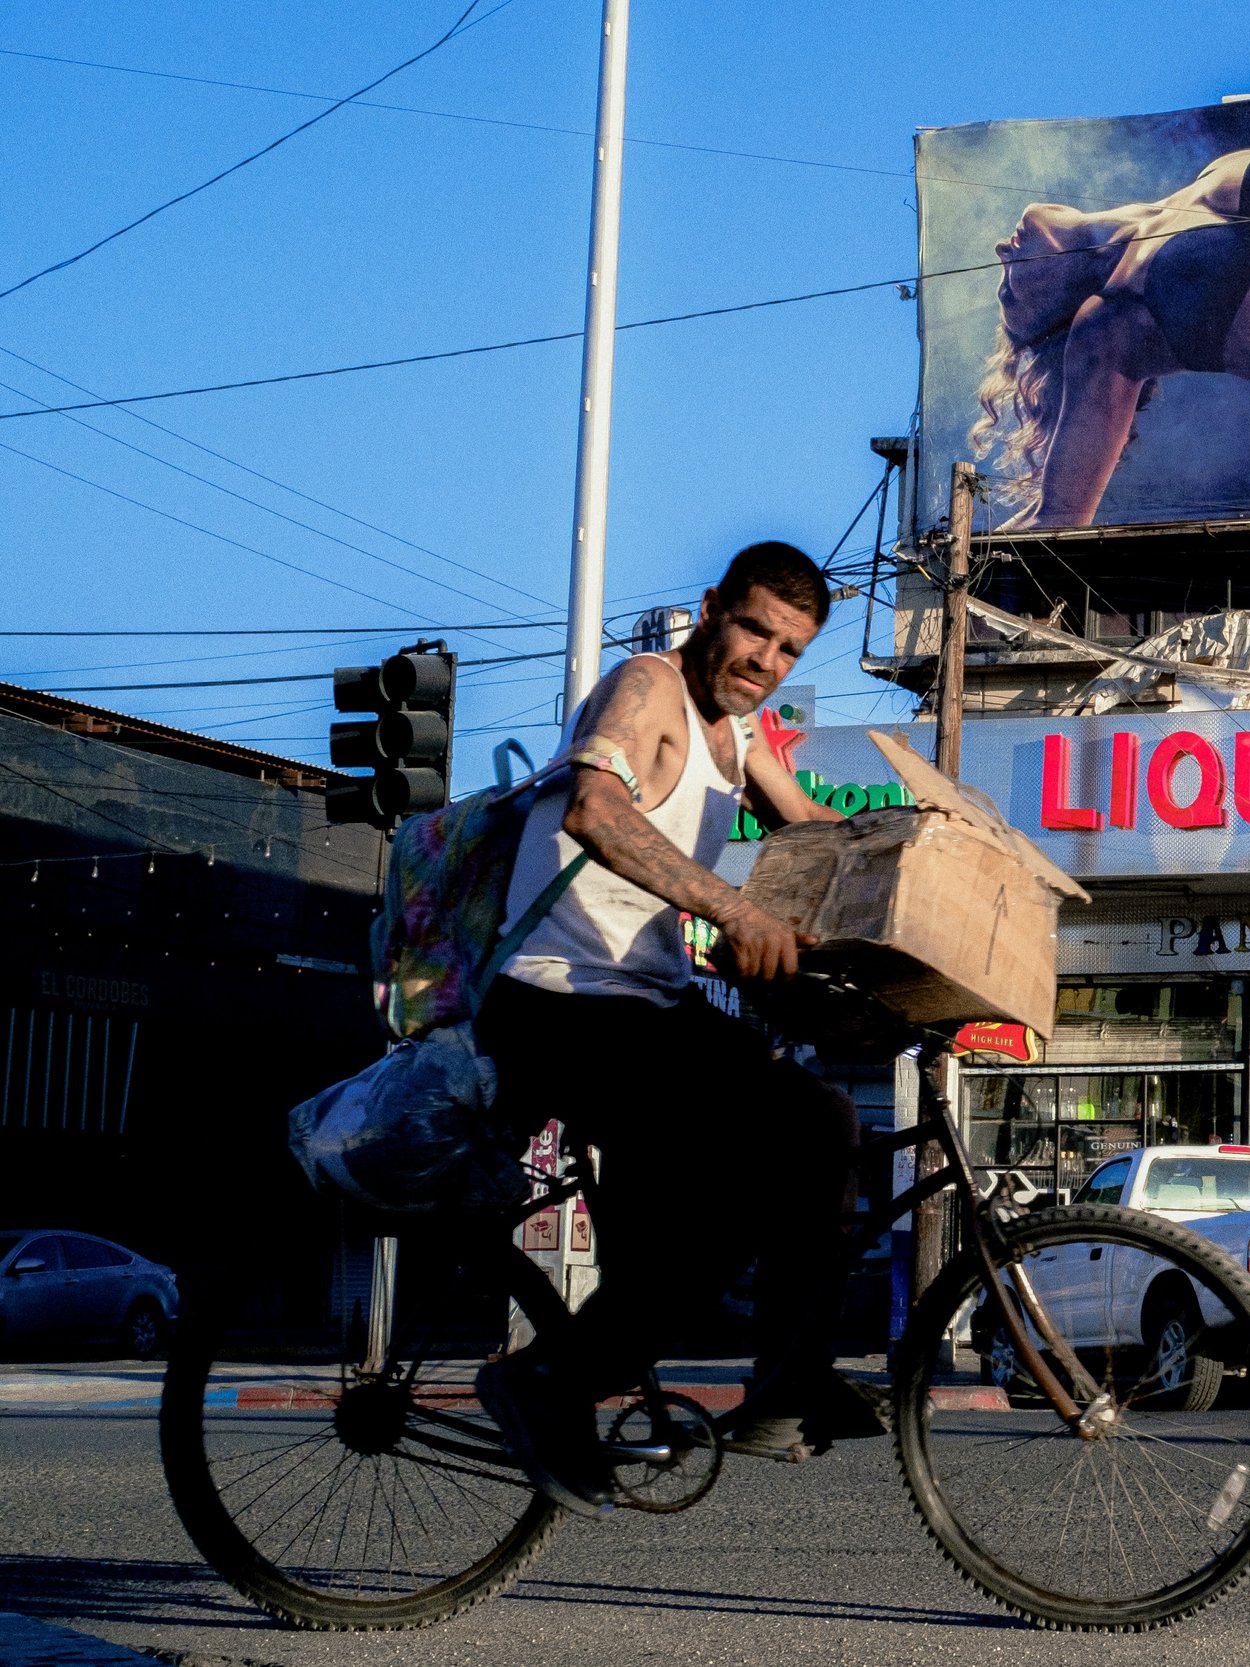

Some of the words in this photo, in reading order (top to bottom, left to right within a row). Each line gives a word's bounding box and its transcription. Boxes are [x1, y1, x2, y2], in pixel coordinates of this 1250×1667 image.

[970, 1033, 993, 1044] HIGH
[995, 1037, 1014, 1047] LIFE
[1090, 1141, 1142, 1150] GENUIN
